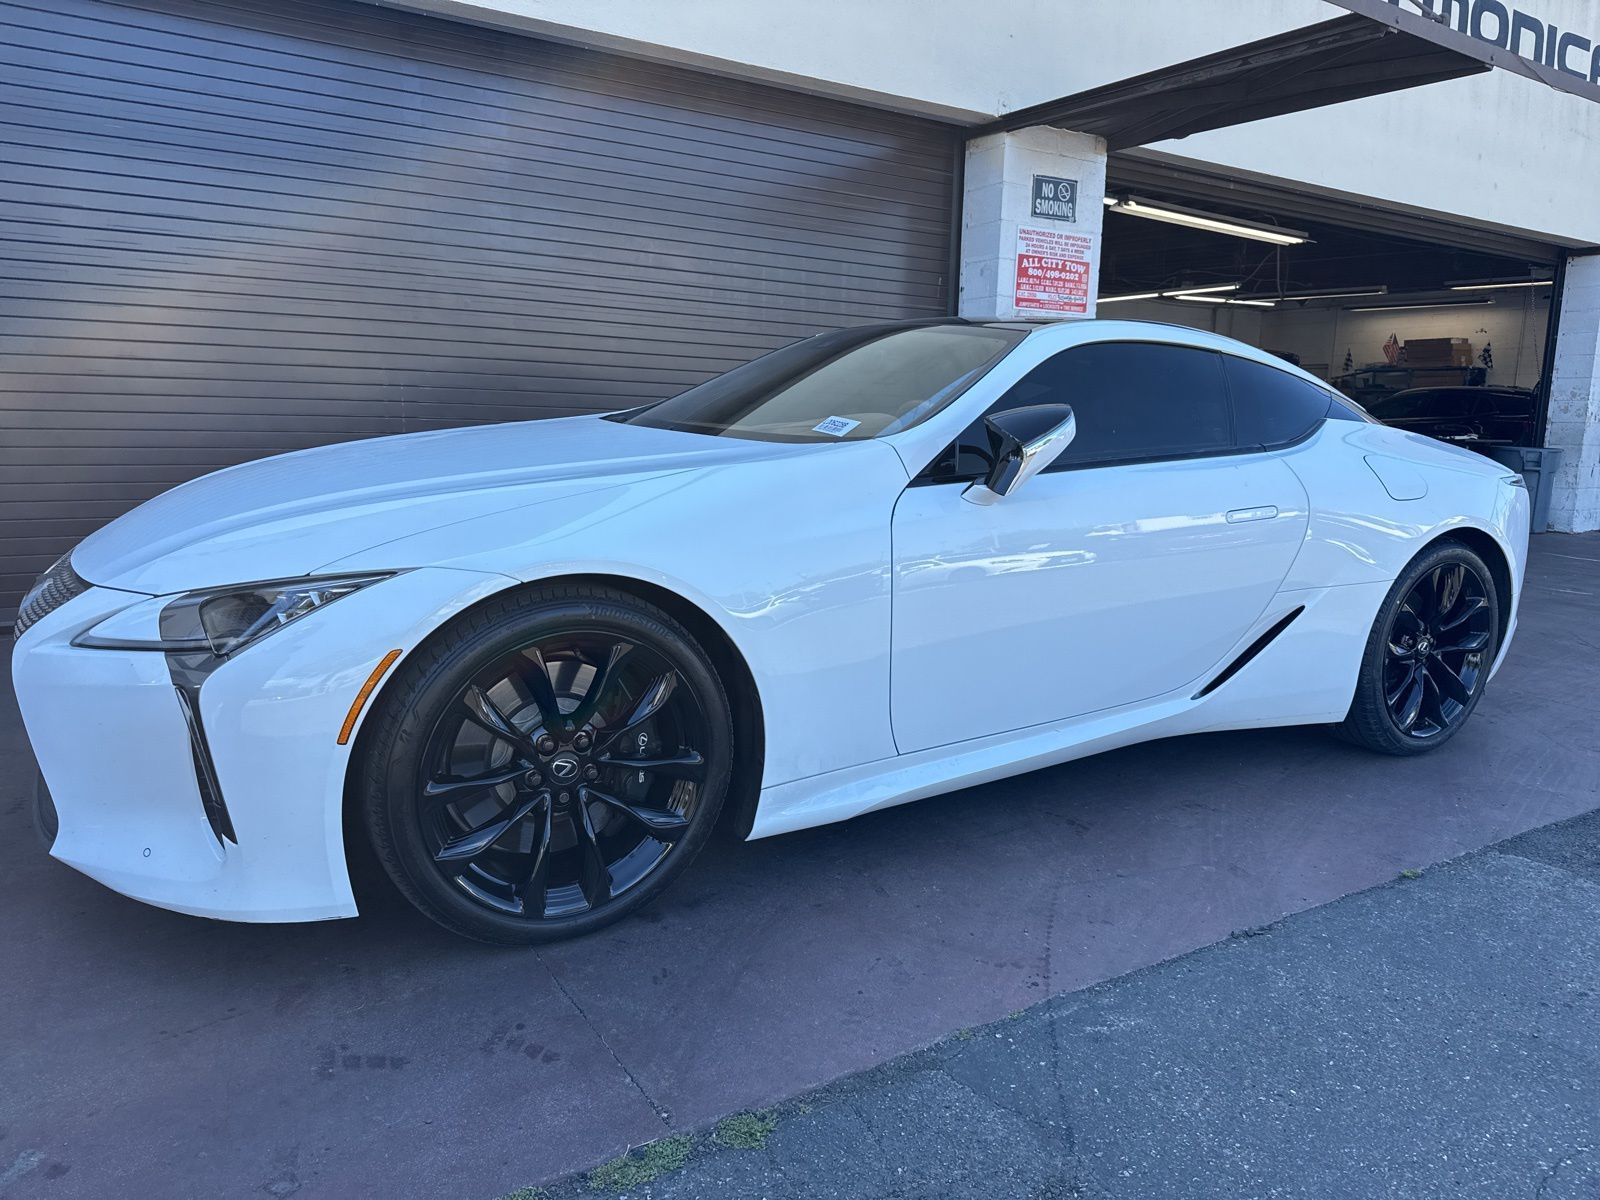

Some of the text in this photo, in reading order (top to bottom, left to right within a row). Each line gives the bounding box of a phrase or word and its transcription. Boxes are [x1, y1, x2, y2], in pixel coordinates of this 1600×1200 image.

[1042, 182, 1054, 198] NO
[1035, 198, 1073, 217] SMOKING
[1022, 258, 1086, 273] ALL CITY TOW
